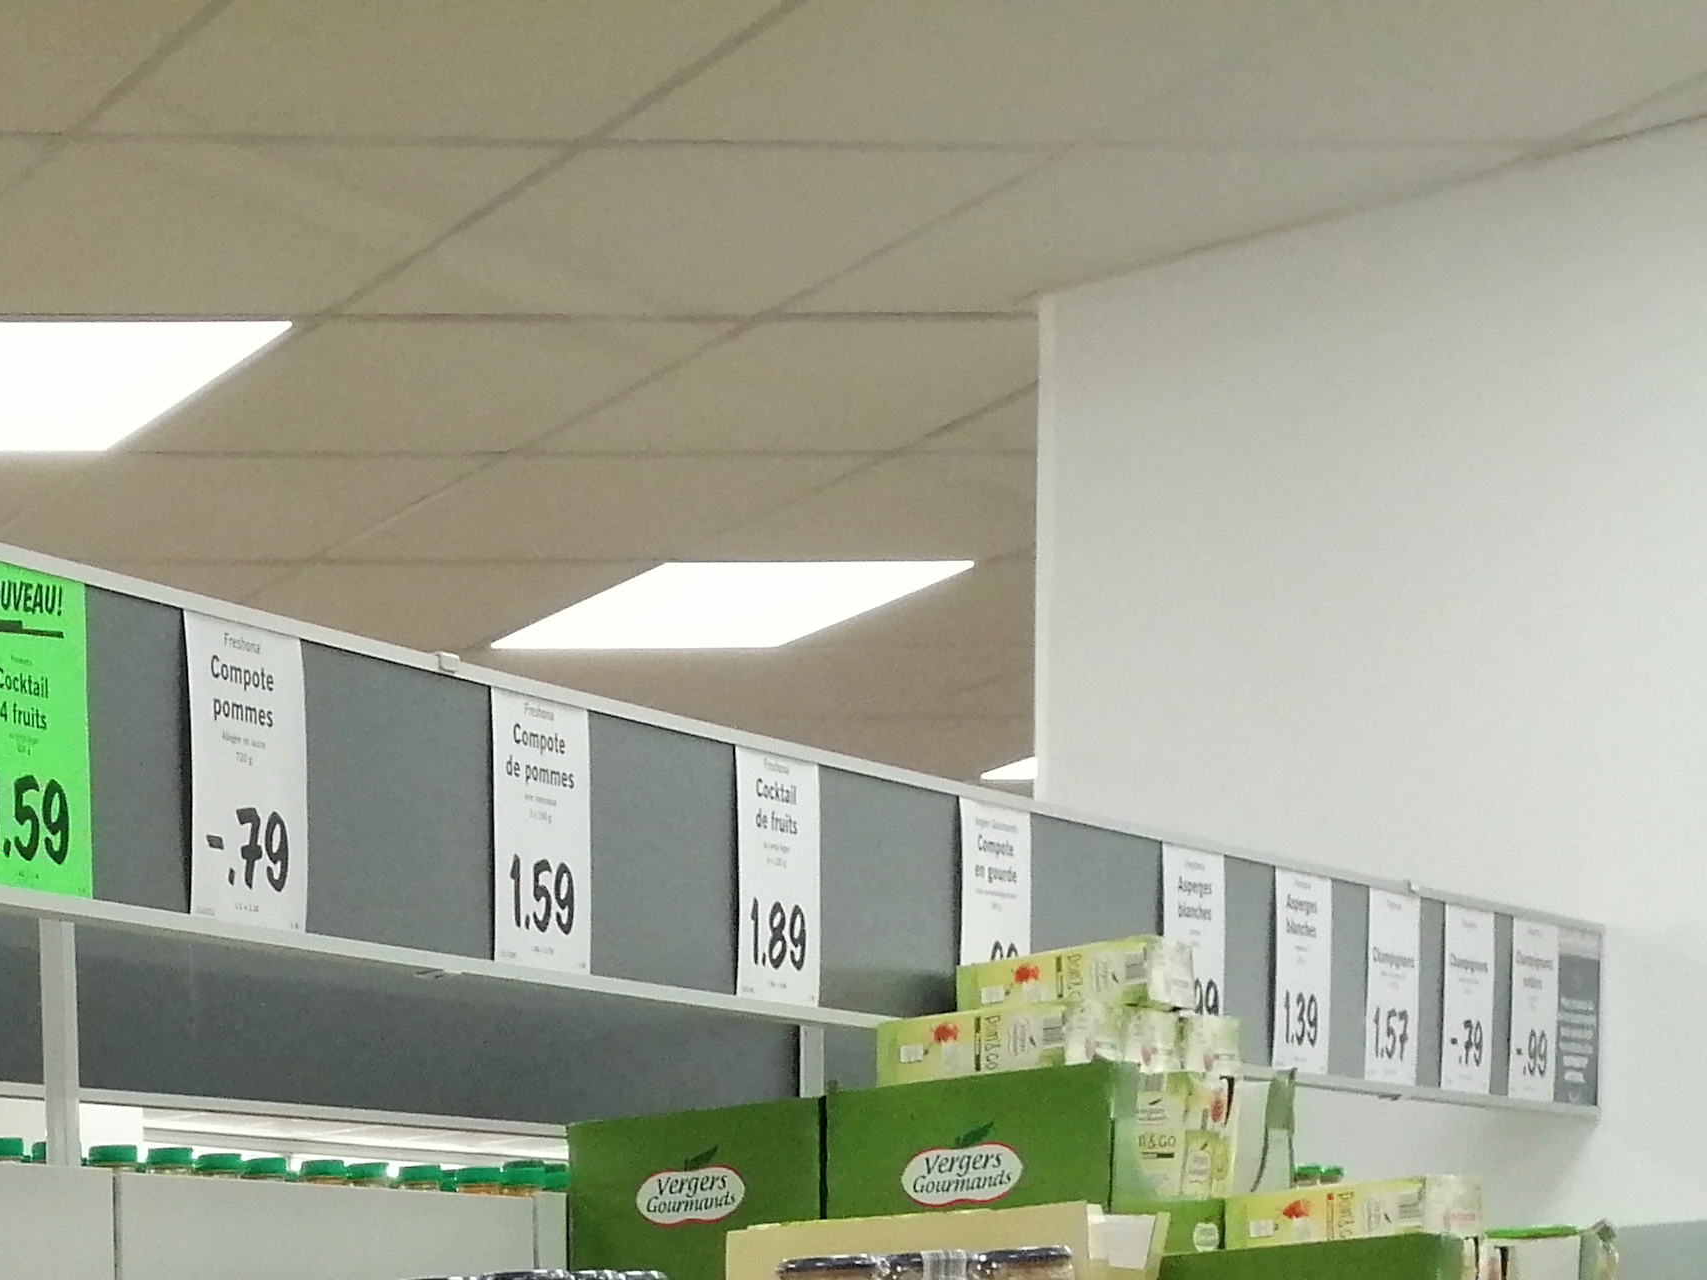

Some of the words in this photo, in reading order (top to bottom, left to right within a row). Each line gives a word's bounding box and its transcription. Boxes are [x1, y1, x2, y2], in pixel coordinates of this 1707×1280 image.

[211, 655, 274, 691] Compote
[0, 701, 7, 722] 4
[13, 702, 47, 730] fruits
[213, 698, 273, 727] pommes
[513, 723, 566, 755] Compote
[506, 755, 520, 778] de
[525, 764, 575, 789] pommes
[756, 778, 797, 805] Cocktail
[756, 808, 768, 829] de
[771, 811, 797, 835] fruits
[205, 807, 289, 892] -.79
[977, 834, 1014, 858] Compote
[510, 854, 575, 935] 1.59
[751, 897, 806, 972] 1.89
[1284, 990, 1318, 1048] 1.39
[1373, 1006, 1409, 1062] 1.57
[1516, 1028, 1548, 1077] -.99
[923, 1144, 1005, 1177] Vergers
[656, 1171, 728, 1200] Vergers
[913, 1166, 1014, 1195] Gourmands
[646, 1194, 736, 1215] Gourmands
